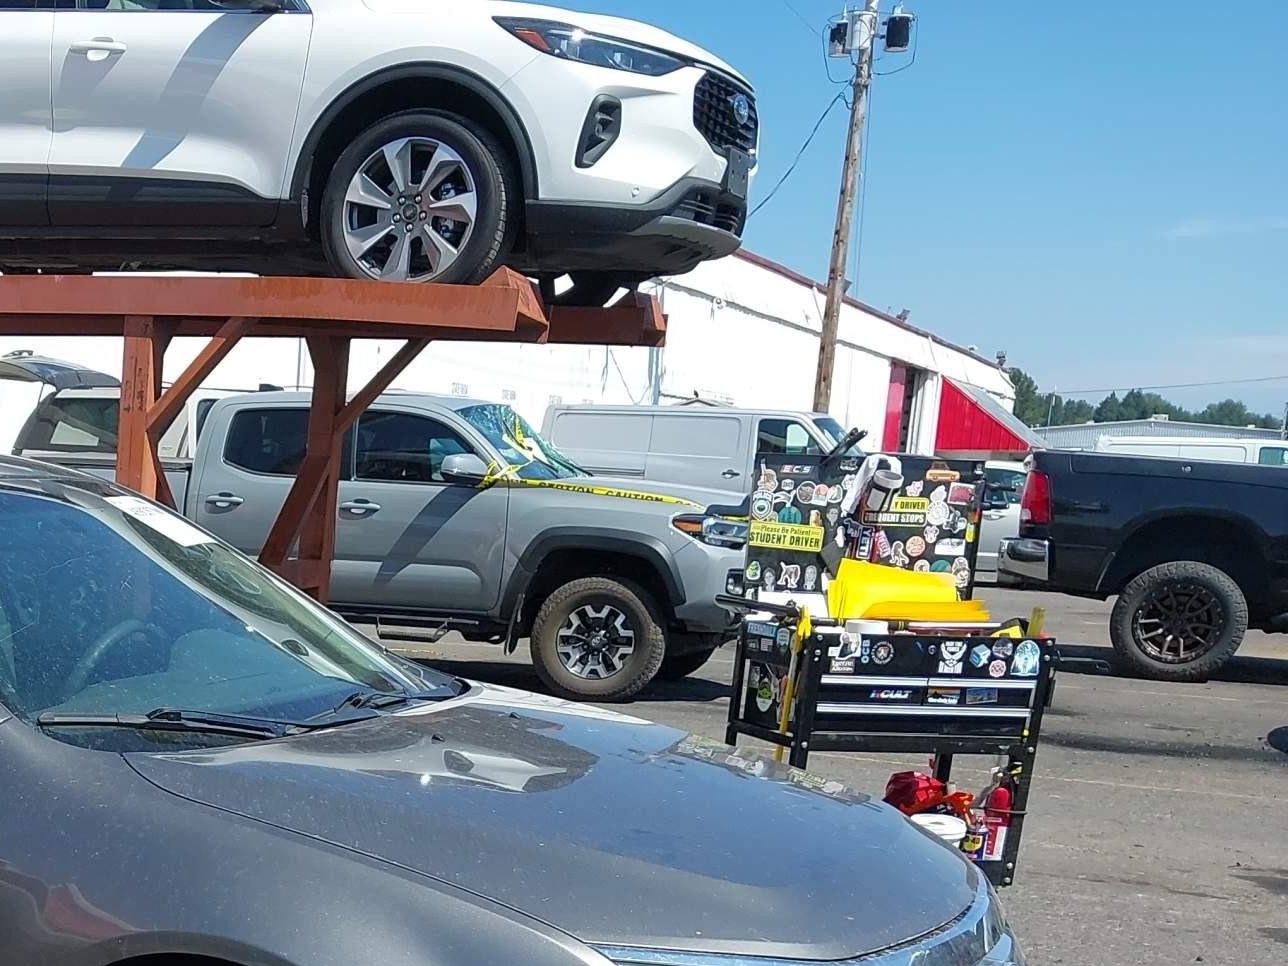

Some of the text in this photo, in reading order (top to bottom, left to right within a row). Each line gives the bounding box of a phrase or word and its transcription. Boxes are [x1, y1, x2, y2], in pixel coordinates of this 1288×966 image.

[781, 464, 812, 474] ECS
[900, 501, 926, 510] DRIVER
[901, 513, 924, 523] STOPS
[760, 524, 811, 536] Please Be Patient
[749, 531, 820, 548] STUDENT DRIVER
[859, 529, 871, 556] YETI
[860, 639, 871, 664] OCB
